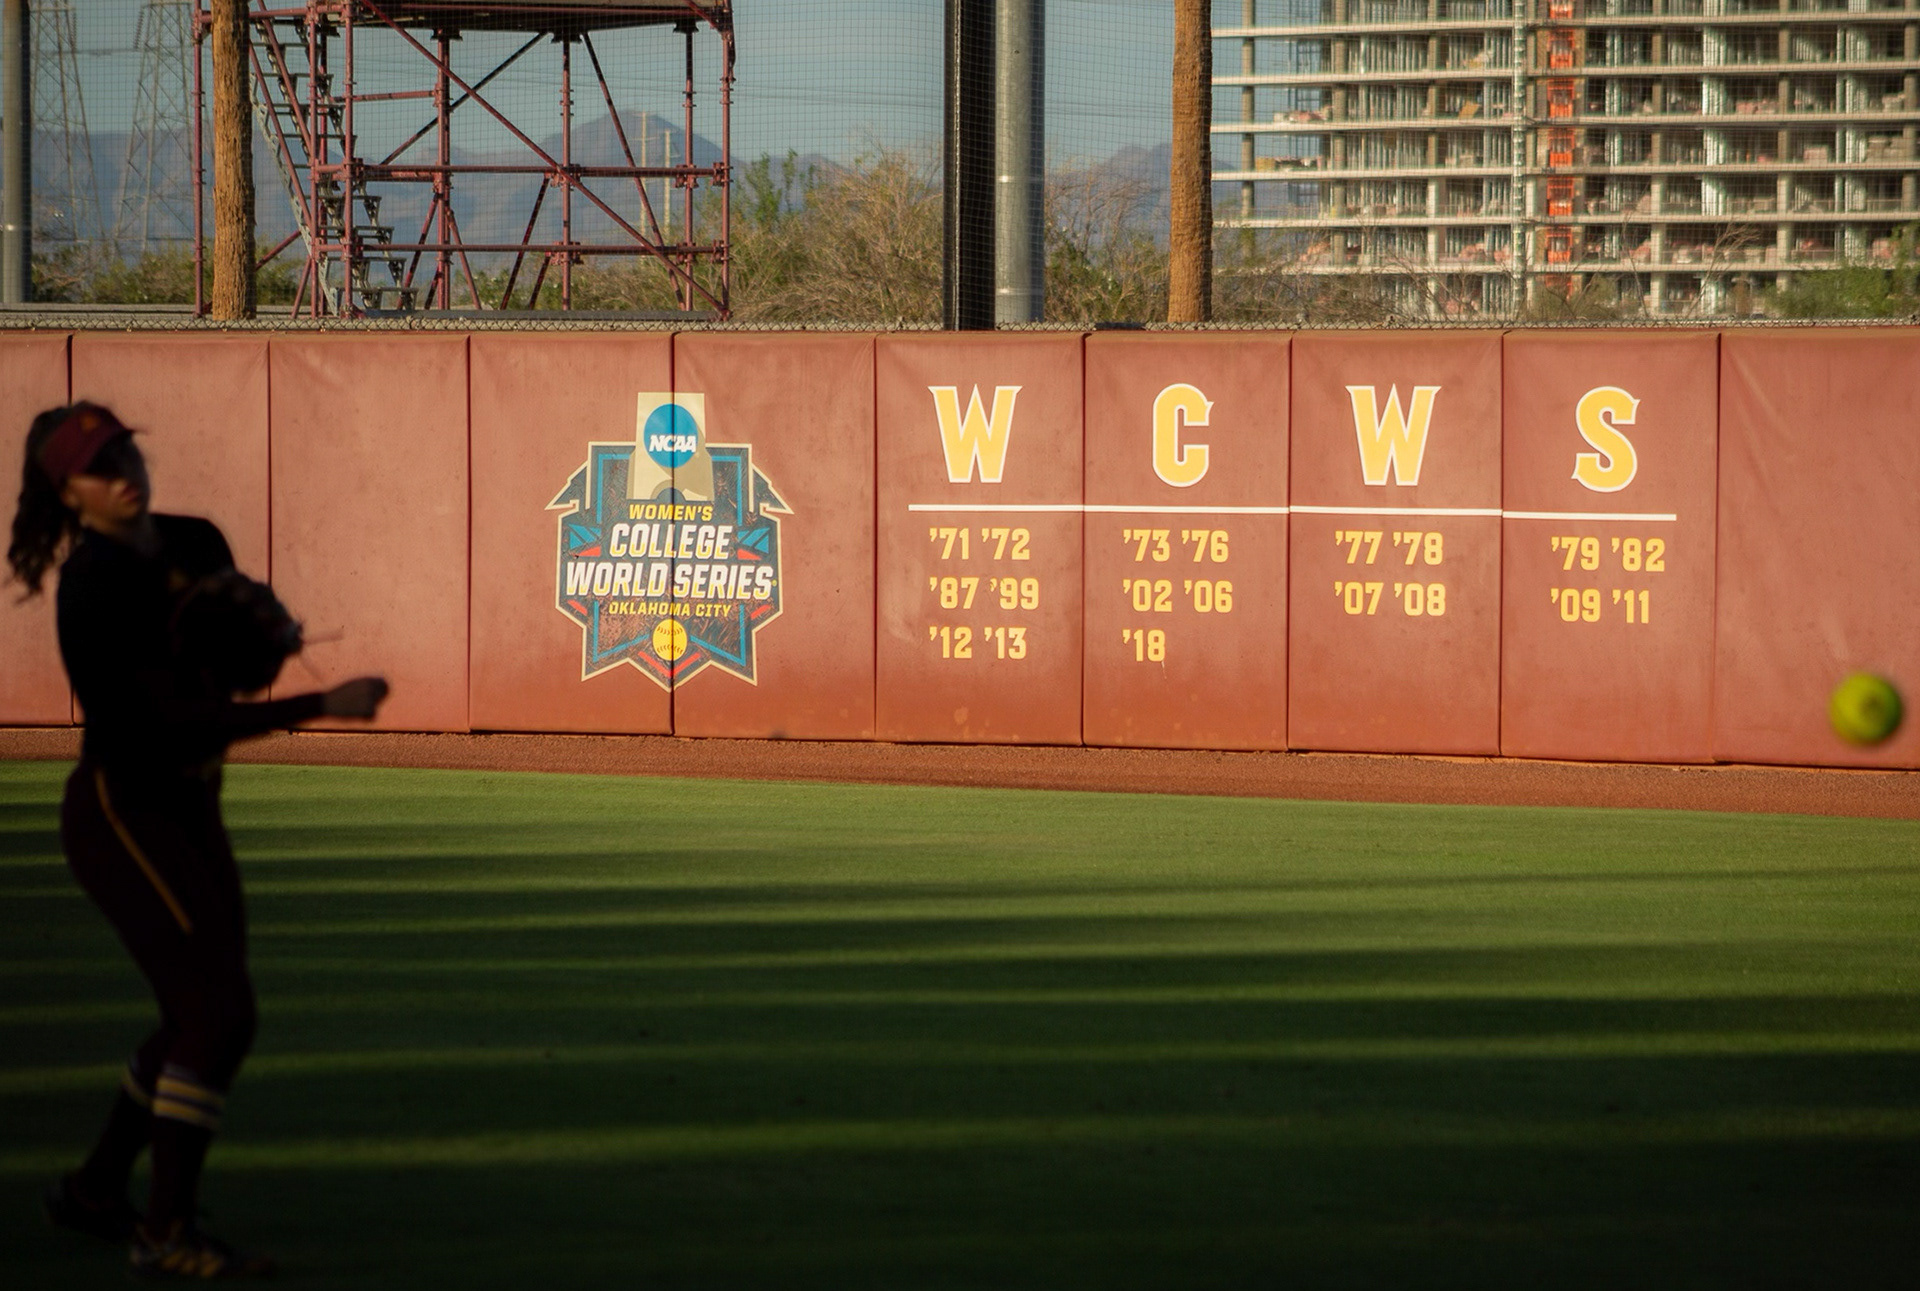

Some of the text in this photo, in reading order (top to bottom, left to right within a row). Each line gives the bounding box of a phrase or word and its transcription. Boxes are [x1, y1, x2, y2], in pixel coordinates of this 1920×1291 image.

[648, 435, 696, 452] NCAA
[928, 383, 1640, 492] W C W S
[629, 504, 713, 521] WOMEN'S
[609, 523, 733, 559] COLLEGE
[929, 528, 1665, 572] '71 '72 '73 '76 '77 '78 '79 '82
[566, 562, 669, 596] WORLD
[609, 602, 731, 617] OKLAHOMA CITY
[929, 577, 1649, 624] '87 '99 '02 '06 '07 '08 '09 '11
[929, 626, 1165, 662] '12 '13 '18
